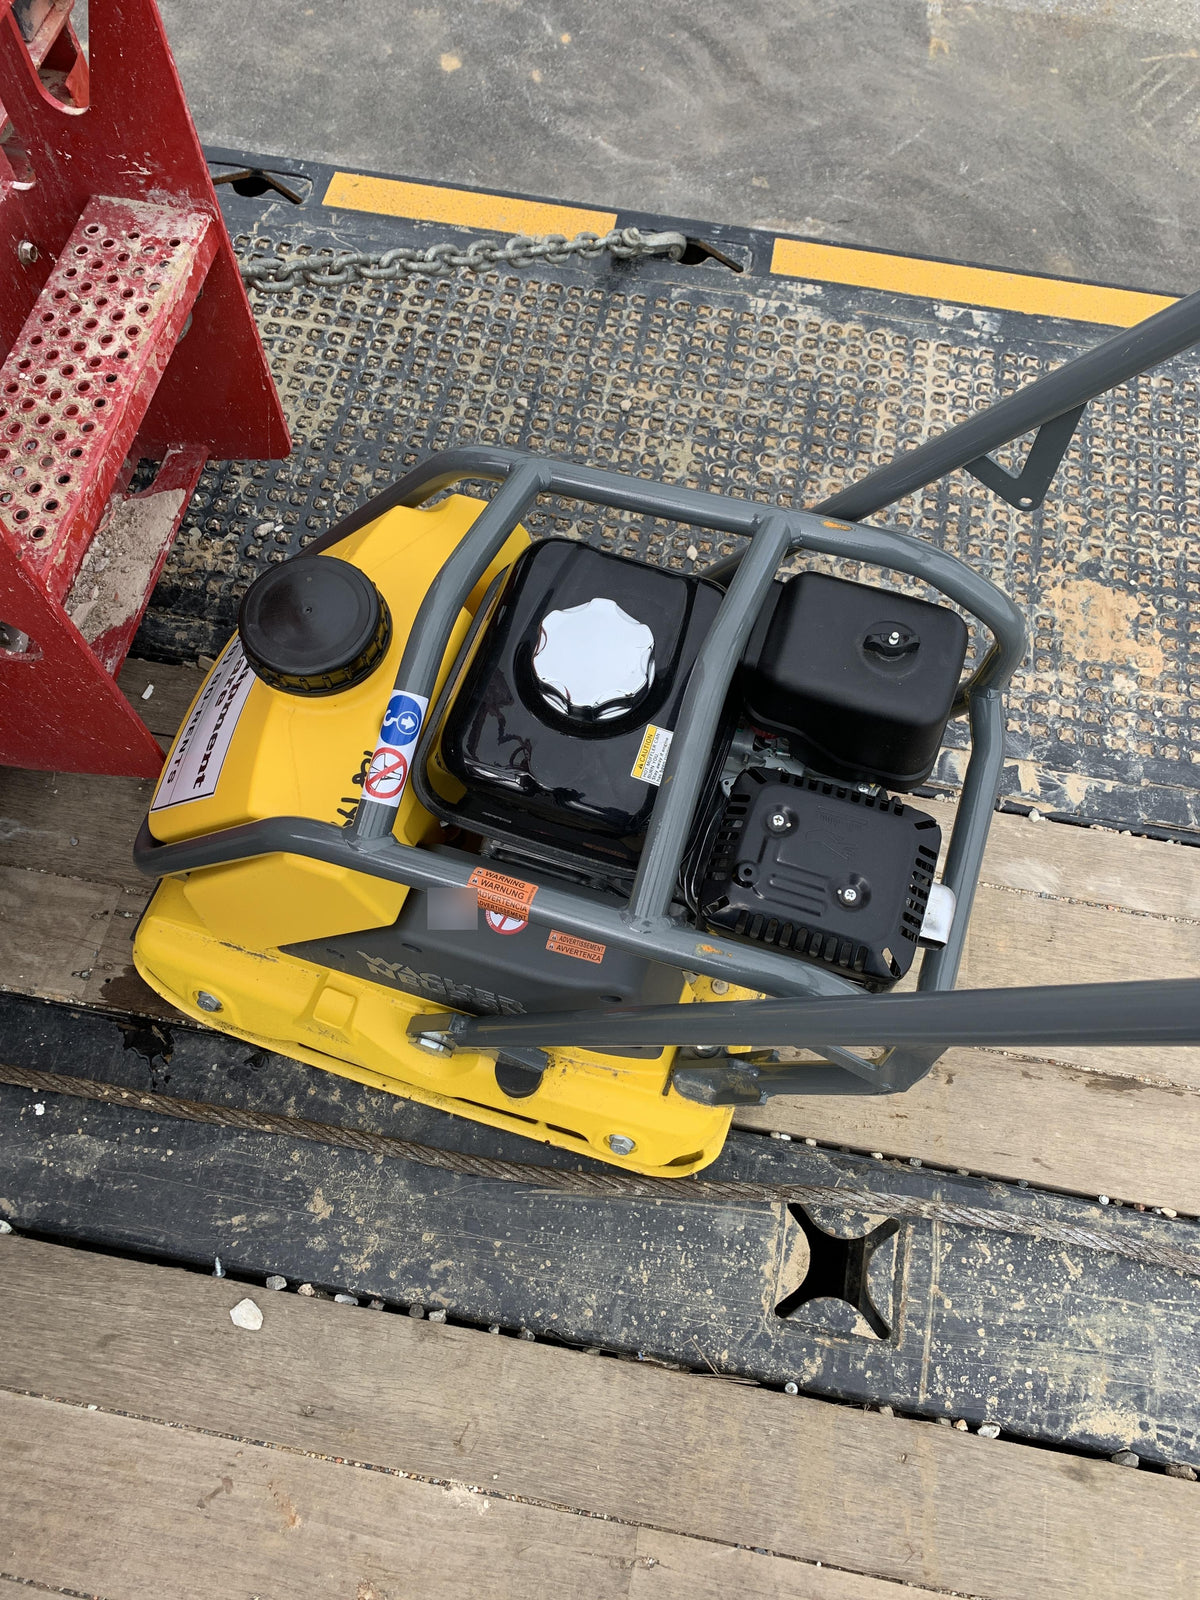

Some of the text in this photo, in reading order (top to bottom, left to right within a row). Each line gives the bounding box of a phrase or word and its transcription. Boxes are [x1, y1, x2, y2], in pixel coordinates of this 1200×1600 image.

[640, 734, 653, 762] CAUTION
[647, 745, 656, 766] MUFFLER
[481, 879, 525, 900] WARNUNG
[485, 871, 526, 889] WARNING
[478, 889, 527, 913] ADVERTENCIA
[556, 944, 601, 962] AVVERTENZA
[559, 935, 605, 953] ADVERTISSEMENT
[356, 950, 527, 1014] WACKER
